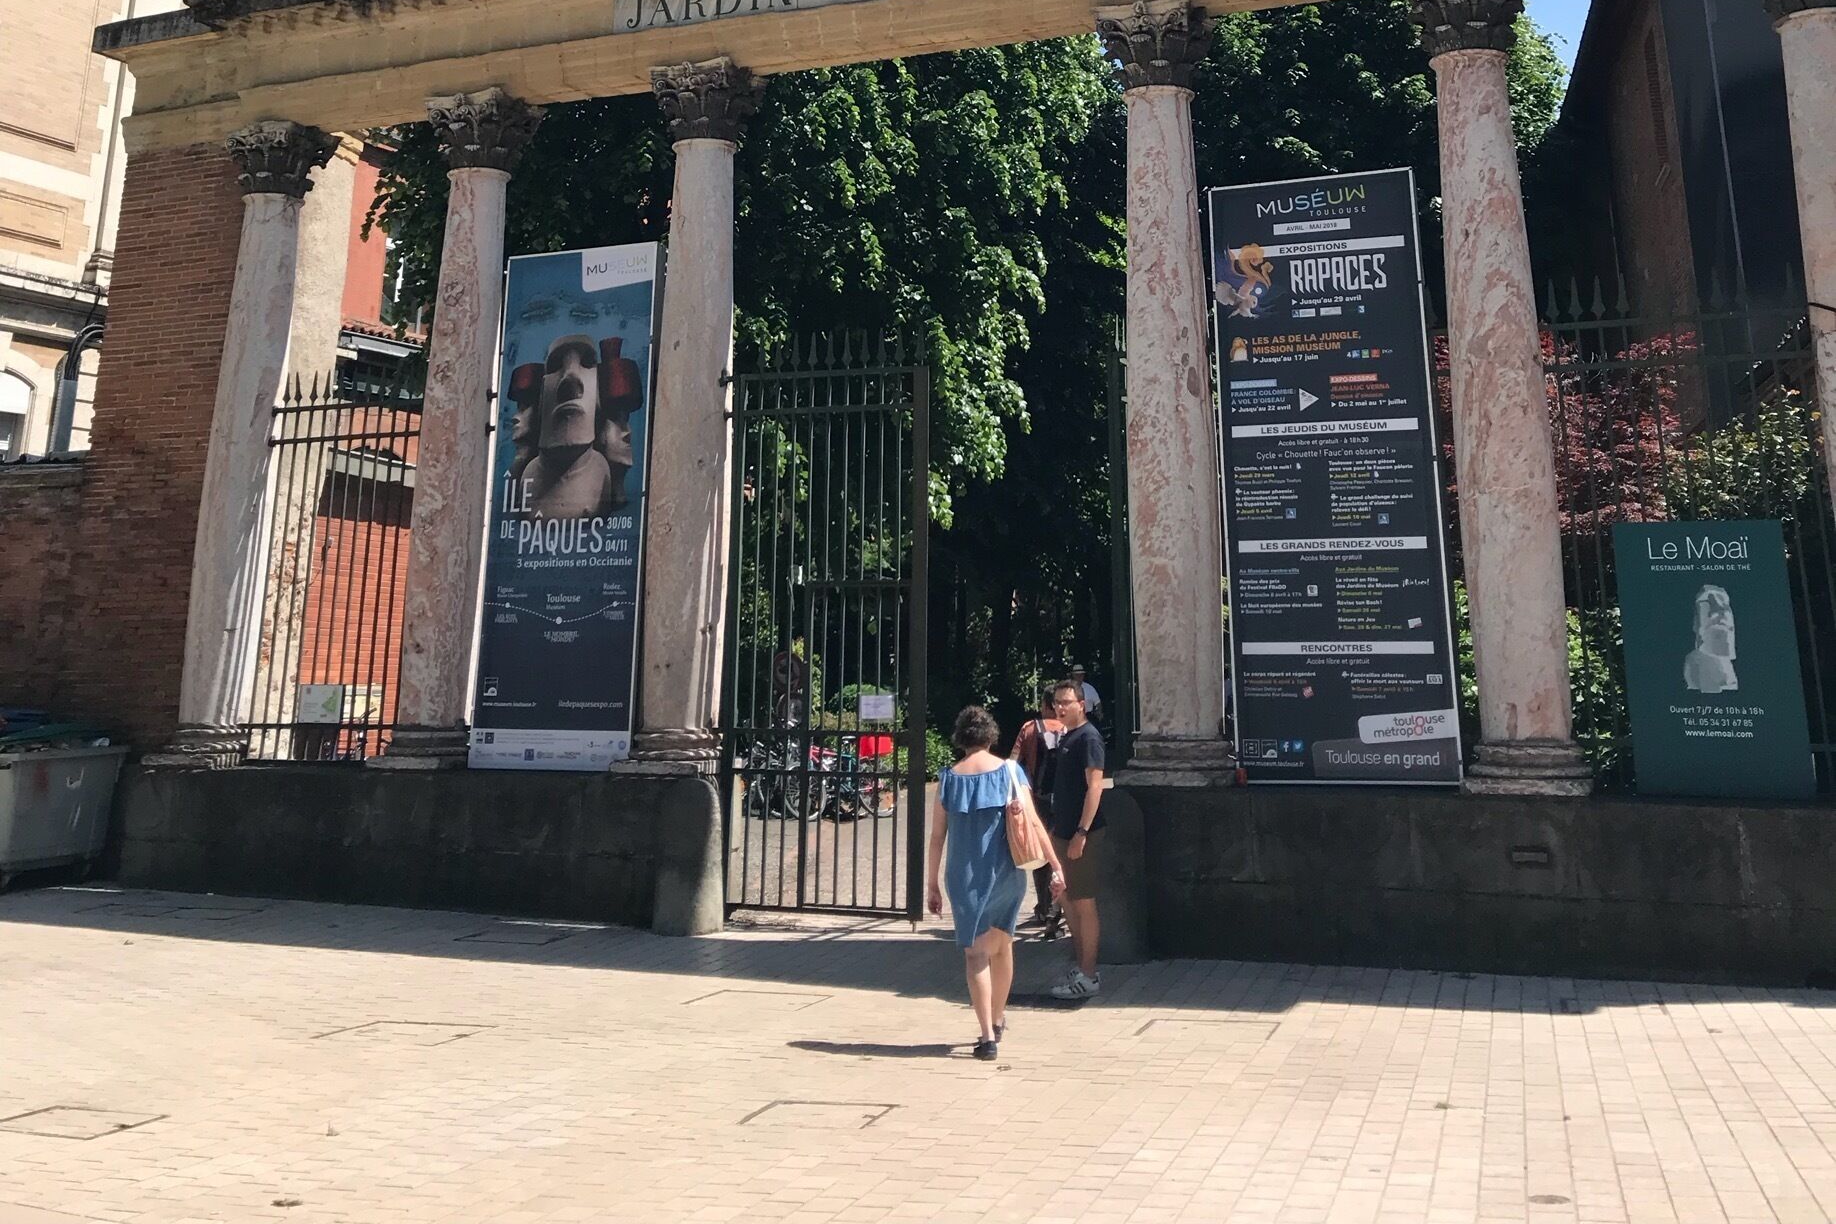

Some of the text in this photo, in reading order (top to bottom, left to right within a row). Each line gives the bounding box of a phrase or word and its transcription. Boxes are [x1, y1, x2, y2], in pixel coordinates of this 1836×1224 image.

[1309, 205, 1367, 217] TOULOUSE
[1286, 224, 1305, 233] AVRIL
[1309, 222, 1322, 231] MAI
[1279, 242, 1348, 255] EXPOSITIONS
[1289, 253, 1388, 295] RAPACES
[1299, 294, 1362, 307] Jusqu'au 29 avril
[1251, 331, 1361, 346] LES AS DE LA JUNGLE,
[1252, 340, 1341, 355] MISSION MUSÉUM
[1259, 351, 1319, 364] Jusqu'au 17 juin
[1230, 390, 1258, 399] FRANCE
[1238, 398, 1252, 406] VOL
[1338, 400, 1348, 408] Du
[1349, 399, 1354, 407] 2
[1354, 399, 1368, 407] mai
[1368, 398, 1377, 406] au
[1260, 421, 1388, 435] LES JEUDIS DU MUSÉUM
[1256, 450, 1276, 461] Cycle
[503, 469, 534, 514] ÎLE
[500, 510, 633, 557] DE PÂQUES 30/06
[604, 539, 628, 554] 04/11
[1260, 539, 1405, 551] LES GRANDS RENDEZ-VOUS
[1647, 535, 1749, 560] Le Moaï
[517, 555, 633, 570] 3 expositions en Occitanie
[1650, 564, 1695, 572] RESTAURANT
[1702, 564, 1725, 572] SALON
[547, 593, 582, 604] Toulouse
[1300, 644, 1373, 654] RENCONTRES
[1669, 705, 1695, 714] Ouvert
[1713, 706, 1723, 715] de
[1742, 707, 1747, 715] à
[1392, 714, 1446, 728] toulouse
[1699, 718, 1709, 726] 05
[1721, 719, 1730, 727] 31
[1732, 719, 1741, 727] 67
[1743, 719, 1754, 728] 85
[1325, 749, 1440, 769] Toulouse en grand
